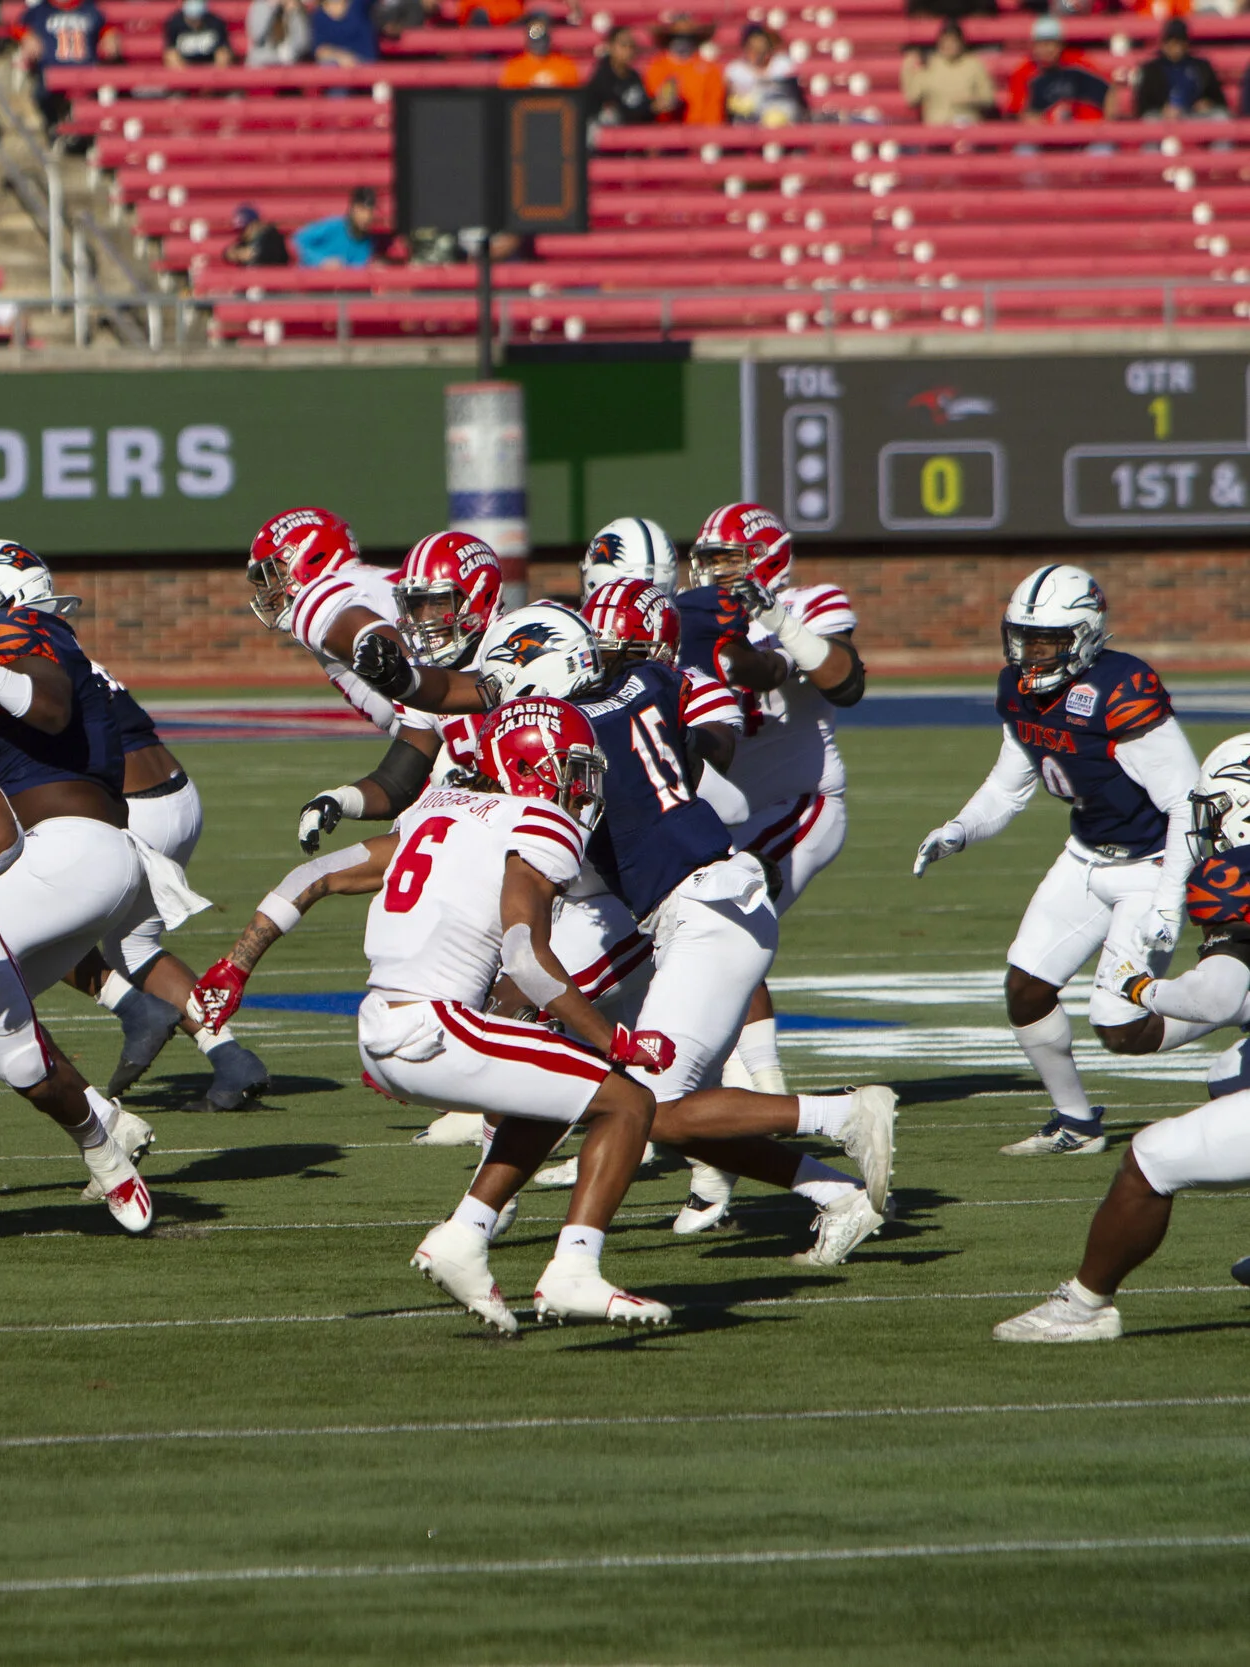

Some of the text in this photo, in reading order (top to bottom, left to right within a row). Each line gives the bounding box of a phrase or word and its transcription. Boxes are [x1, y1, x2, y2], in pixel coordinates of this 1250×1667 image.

[1125, 361, 1194, 393] QTR
[1148, 397, 1172, 439] 1
[920, 456, 962, 516] 0
[1112, 461, 1248, 508] 1ST &
[272, 515, 324, 547] CAJUNS
[494, 714, 563, 741] CAJUNS
[1016, 719, 1078, 754] UTSA
[629, 704, 691, 814] 15
[469, 798, 500, 823] JR.
[383, 815, 459, 913] 6
[637, 1039, 660, 1062] adidas
